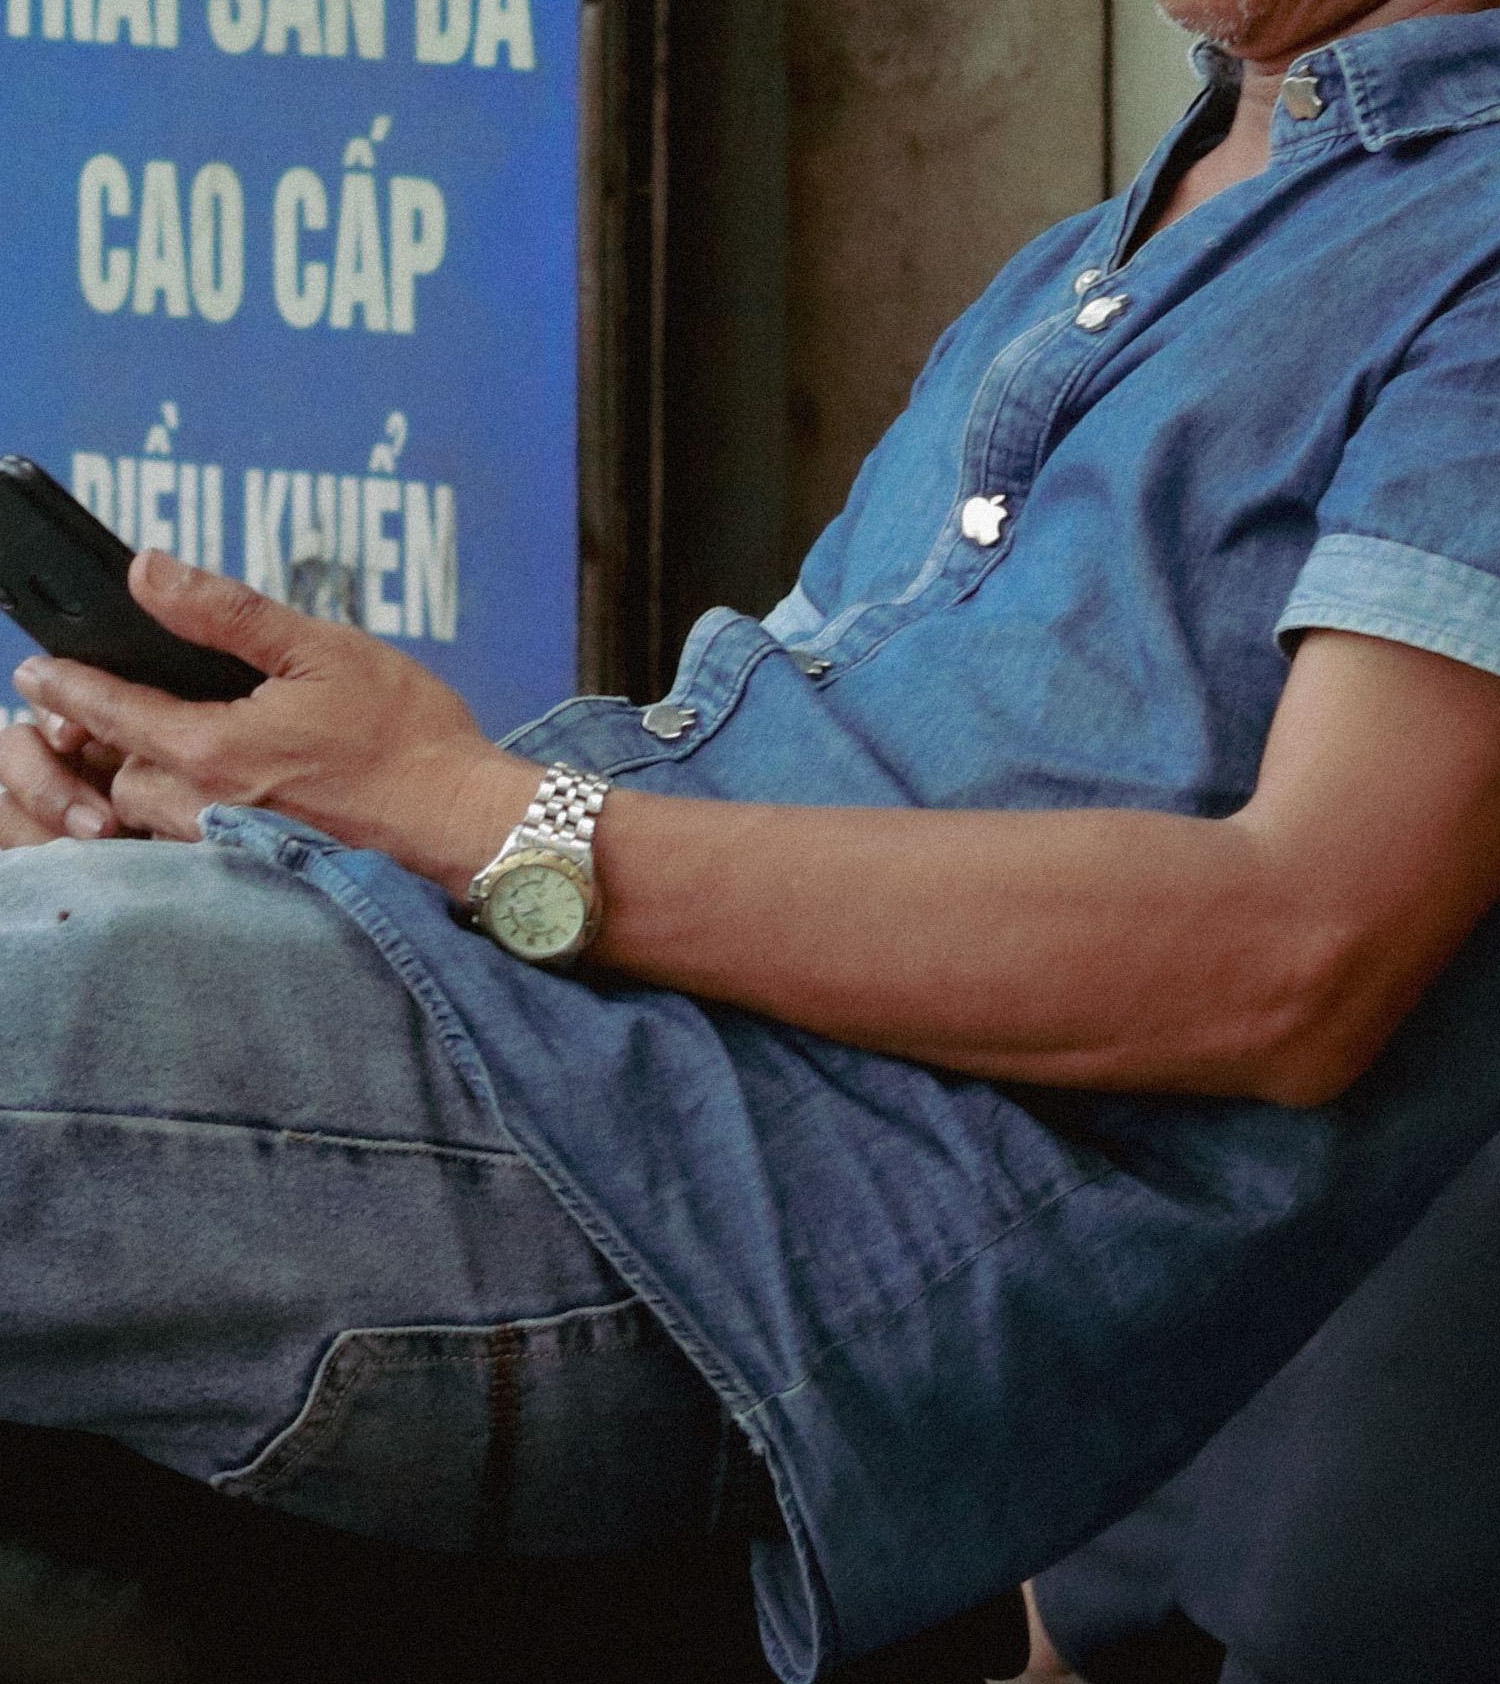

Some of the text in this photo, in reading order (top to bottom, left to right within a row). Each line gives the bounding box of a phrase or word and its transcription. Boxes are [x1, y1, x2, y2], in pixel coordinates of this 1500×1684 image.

[77, 116, 447, 336] CAO CẤP
[244, 411, 459, 644] KHIỂN
